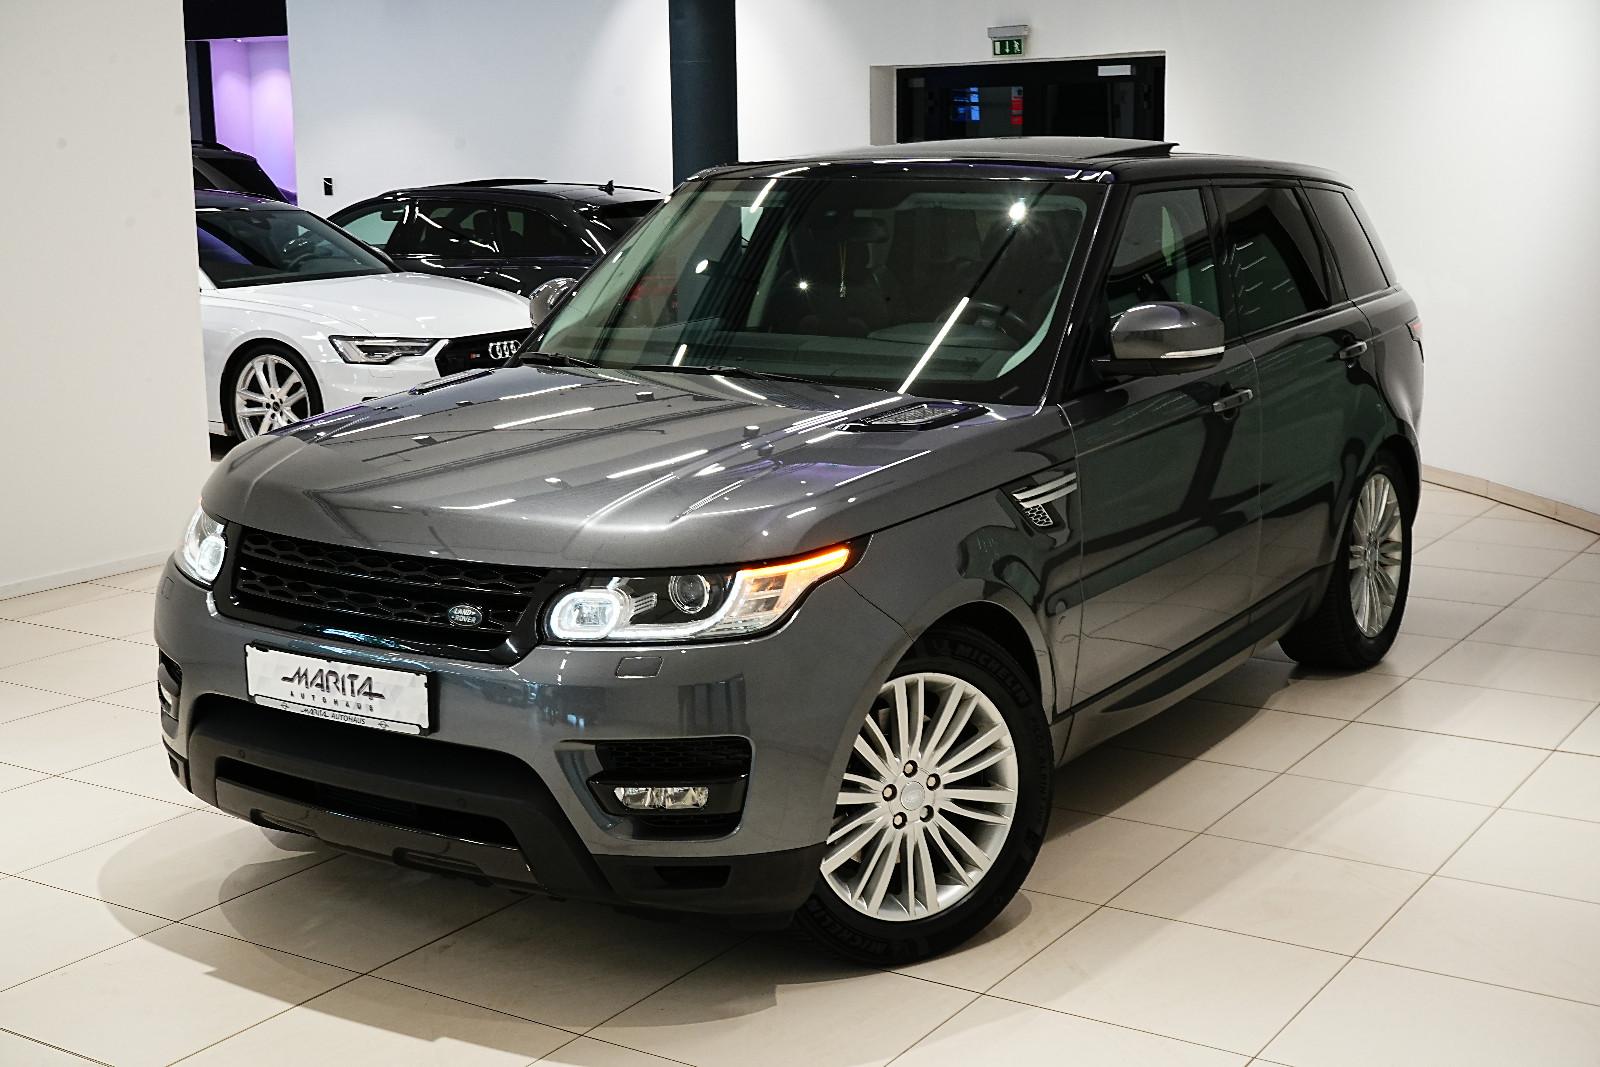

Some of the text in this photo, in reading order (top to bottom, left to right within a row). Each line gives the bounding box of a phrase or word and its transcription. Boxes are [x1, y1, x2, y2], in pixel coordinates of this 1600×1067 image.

[453, 607, 472, 616] LAND
[455, 614, 477, 623] ROVER
[954, 641, 1031, 704] MICHELIN
[281, 666, 385, 700] MARITA
[290, 690, 374, 713] AUTOHAUS
[301, 708, 366, 725] MARITA AUTOHAUS
